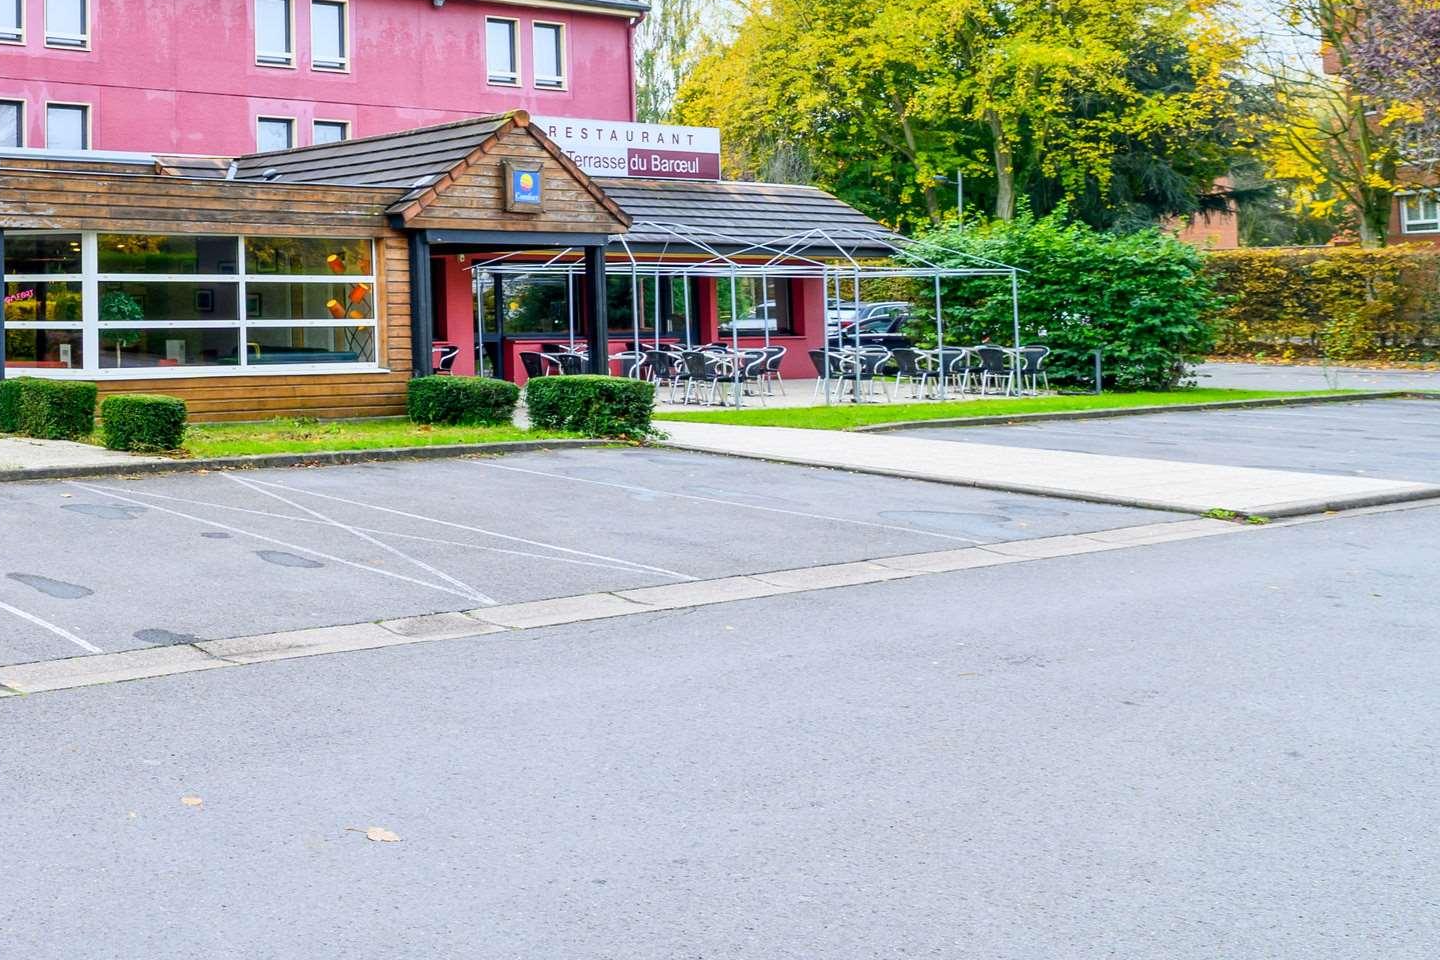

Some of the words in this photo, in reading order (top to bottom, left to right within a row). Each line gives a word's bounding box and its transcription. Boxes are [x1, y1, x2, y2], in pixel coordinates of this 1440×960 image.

[548, 125, 694, 146] RESTAURANT
[630, 153, 647, 171] du
[651, 154, 699, 174] Barœul
